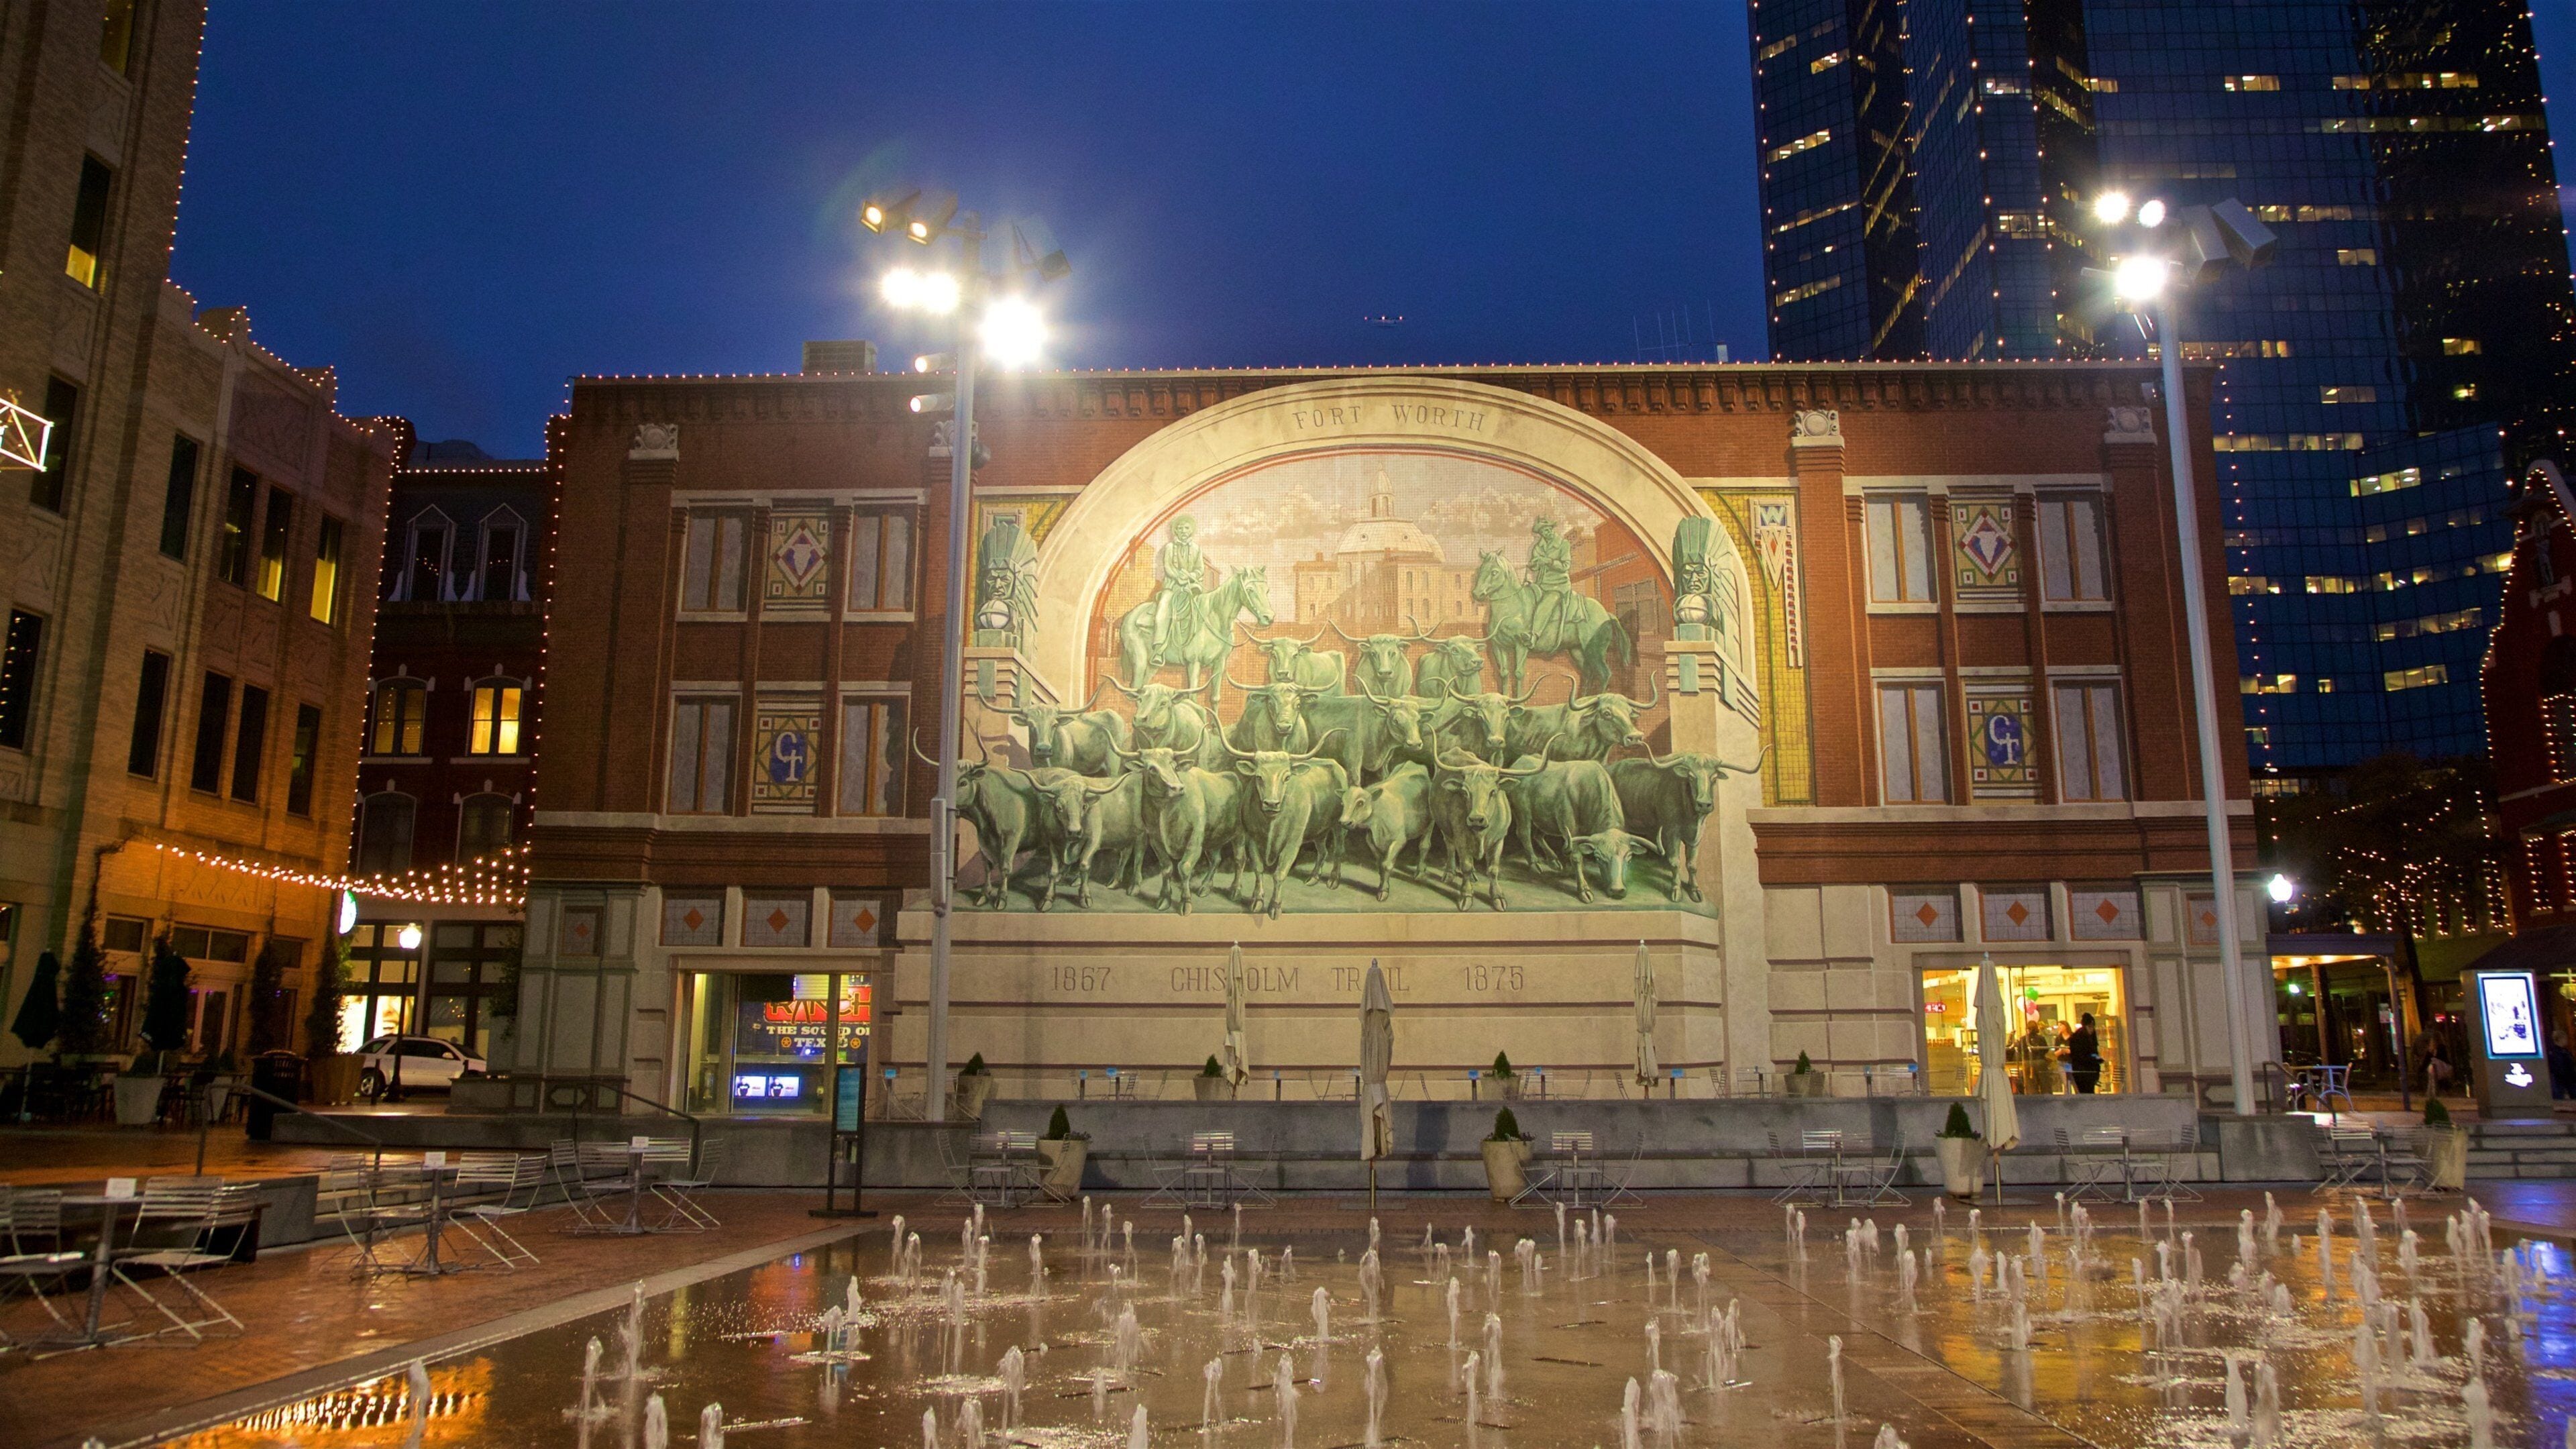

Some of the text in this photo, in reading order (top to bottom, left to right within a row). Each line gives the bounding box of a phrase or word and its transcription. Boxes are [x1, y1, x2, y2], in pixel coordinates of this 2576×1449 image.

[1292, 404, 1487, 432] FORT WORTH
[1051, 965, 1524, 993] 1867 CHISOLM TRIL 1875
[766, 1026, 797, 1035] THE
[794, 1037, 849, 1049] TEXS
